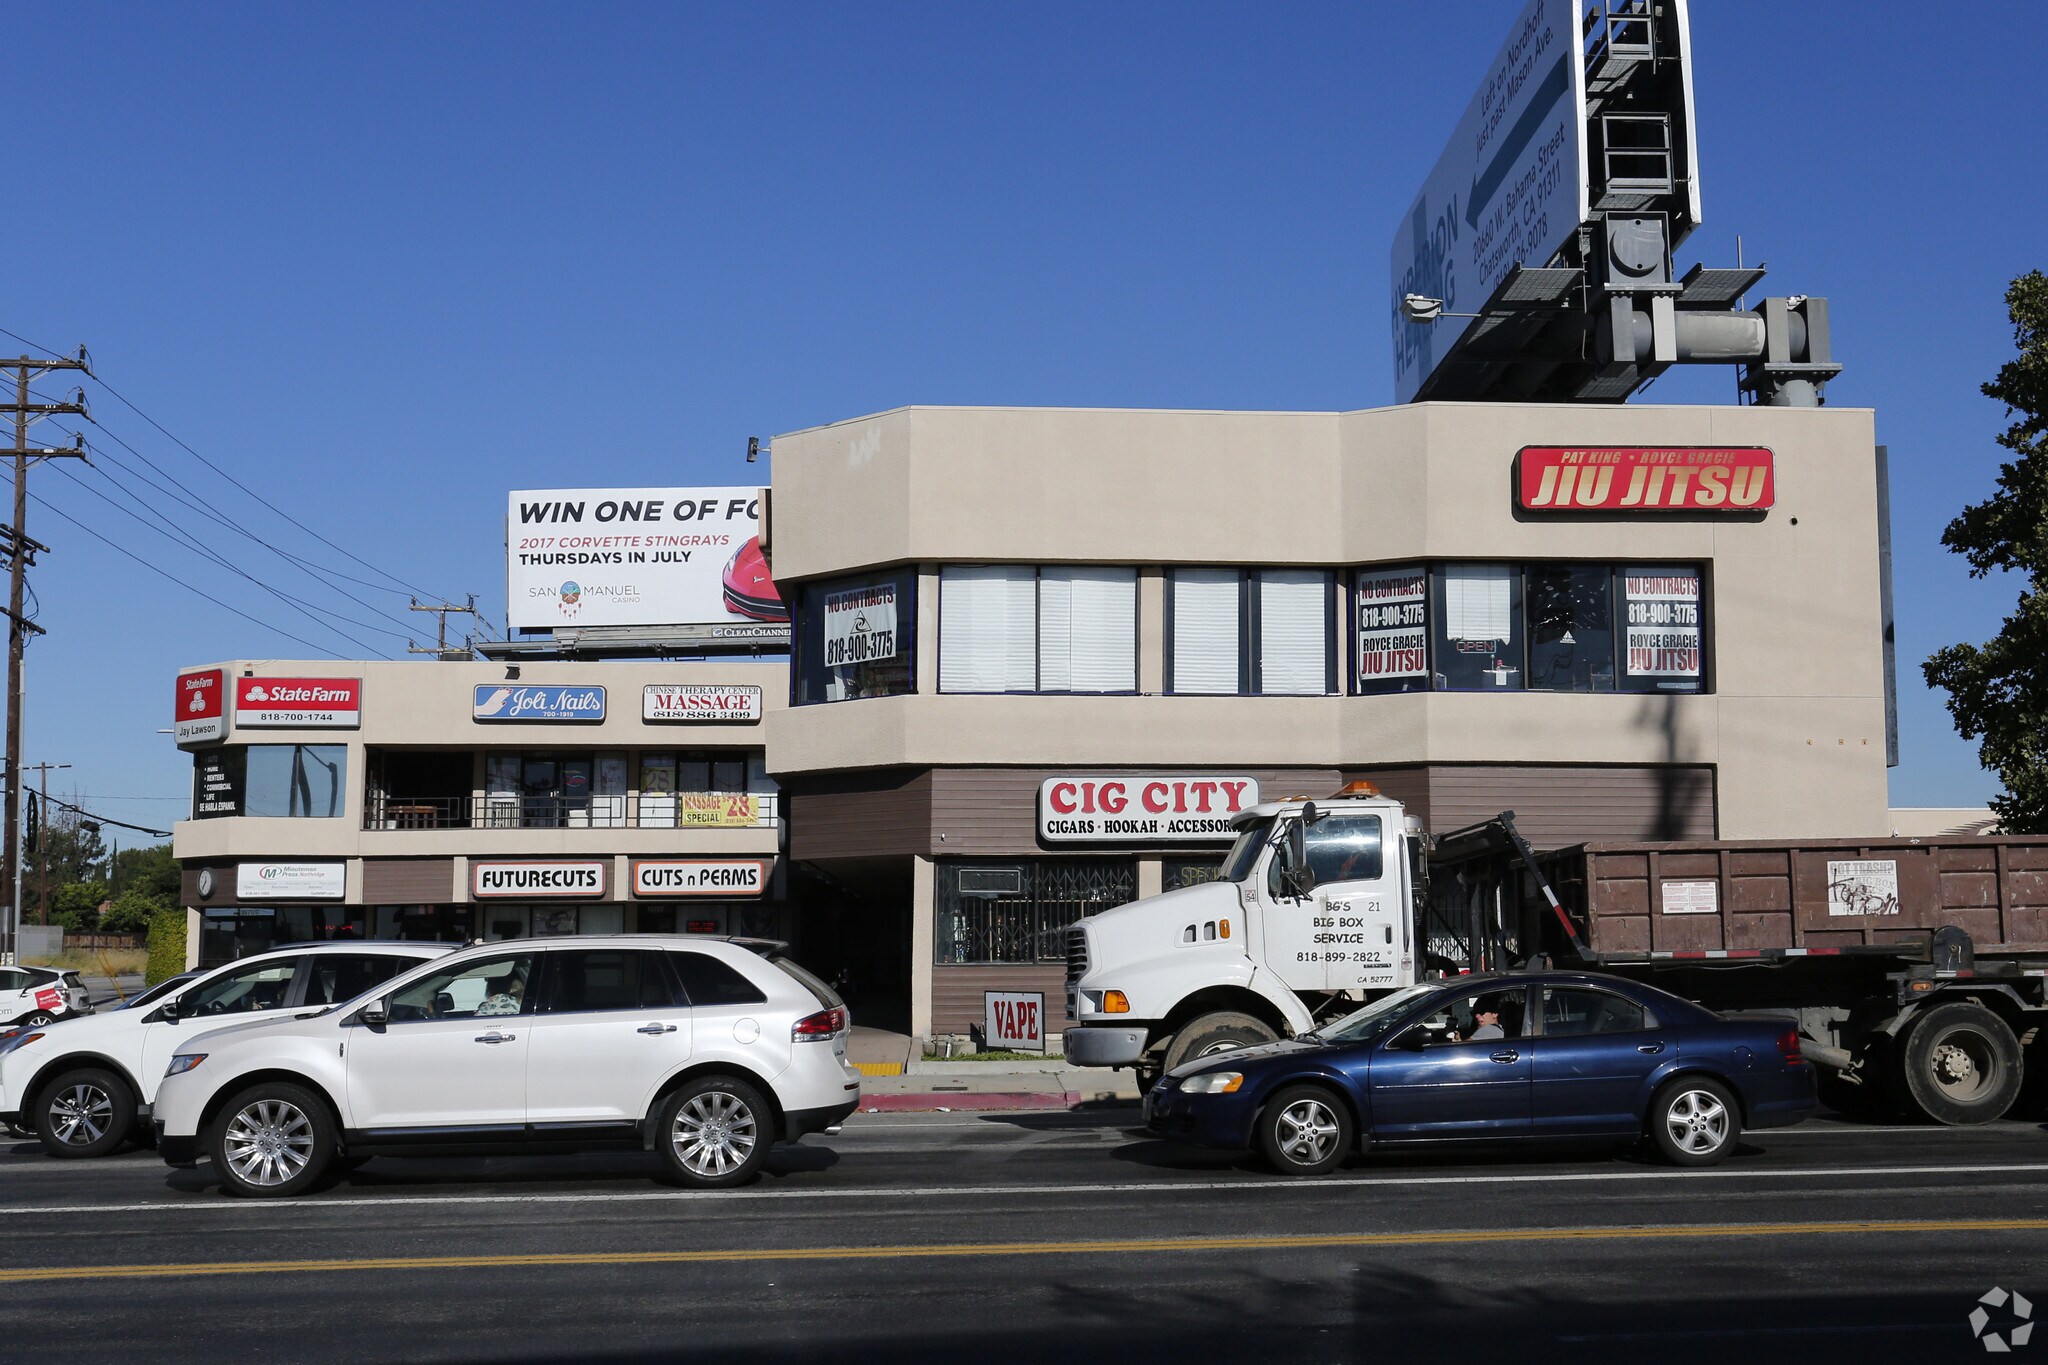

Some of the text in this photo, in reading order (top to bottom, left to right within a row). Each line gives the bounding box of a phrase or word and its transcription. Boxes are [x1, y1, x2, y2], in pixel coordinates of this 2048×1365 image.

[1481, 0, 1545, 118] Left on Nordhoff
[1476, 26, 1554, 163] just past Mason Ave.
[1473, 121, 1565, 265] 20660 W. Bahama Street
[1479, 158, 1561, 286] Chatsworth, CA 91311
[1392, 193, 1459, 338] HYPERION
[1561, 452, 1736, 464] PAT KING ROYCE GRACIE
[1530, 465, 1768, 506] JIU JITSU
[519, 501, 586, 524] WIN
[594, 500, 665, 523] ONE
[673, 499, 719, 521] OF
[519, 535, 730, 549] 2017 CORVETTE STINGRAYS
[519, 551, 692, 565] THURSDAYS IN JULY
[529, 585, 641, 598] SAN MANUEL
[1362, 576, 1425, 599] NO CONTRACTS
[1628, 576, 1697, 595] NO CONTRACTS
[828, 585, 894, 614] NO CONTRACTS
[1362, 603, 1425, 628] 818-900-3775
[1628, 603, 1698, 624] 818-900-3775
[827, 630, 893, 665] 818-900-3775
[1363, 634, 1424, 652] ROYCE GRACIE
[1456, 641, 1494, 651] OPEN
[1630, 634, 1698, 648] ROYCE GRACIE
[1362, 649, 1425, 674] JIU JITSU
[1629, 648, 1698, 671] JIU JITSU
[728, 687, 759, 695] CENTER
[509, 688, 600, 716] Joli Nails
[654, 694, 751, 710] MASSAGE
[261, 713, 333, 721] 818-700-1744
[686, 711, 717, 719] 886
[720, 711, 751, 719] 3499
[179, 724, 216, 738] Jay Lawson
[207, 773, 225, 781] RENTERS
[684, 796, 721, 810] MASSAGE
[1049, 781, 1248, 815] CIG CITY
[199, 802, 205, 811] SE
[205, 802, 218, 811] HABLA
[727, 796, 750, 816] 28
[687, 813, 720, 823] SPECIAL
[1047, 819, 1240, 834] CIGARS HOOKAH ACCESSOR
[1830, 862, 1895, 874] GOT TRASH?
[482, 870, 597, 887] FUTURECUTS
[641, 868, 757, 886] CUTS n PERMS
[1876, 877, 1895, 889] BOX
[1325, 901, 1351, 911] BG'S
[1368, 902, 1381, 912] 21
[1313, 917, 1364, 927] BIG BOX
[1313, 933, 1364, 944] SERVICE
[1296, 951, 1381, 962] 818-899-2822
[1370, 975, 1393, 983] 52777
[993, 1000, 1039, 1041] VAPE
